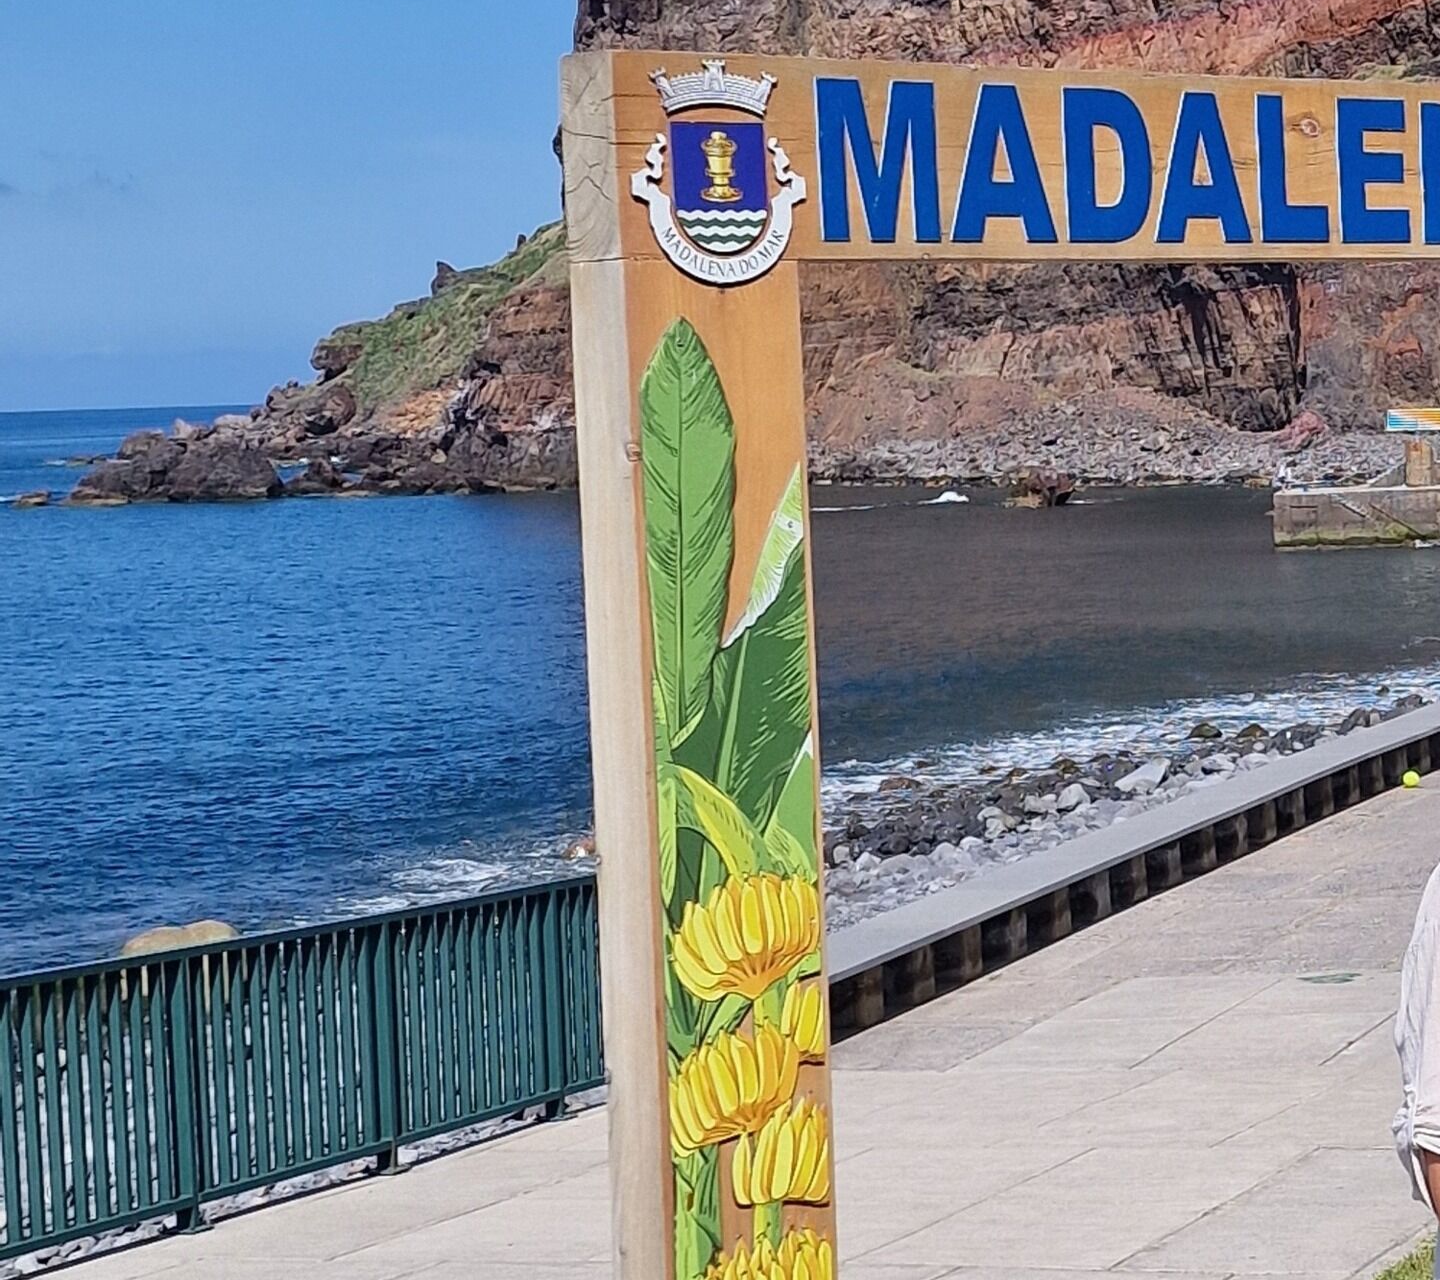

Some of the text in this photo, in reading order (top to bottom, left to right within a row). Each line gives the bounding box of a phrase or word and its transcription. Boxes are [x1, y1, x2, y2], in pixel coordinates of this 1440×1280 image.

[662, 227, 785, 277] MADALENA DO MAR
